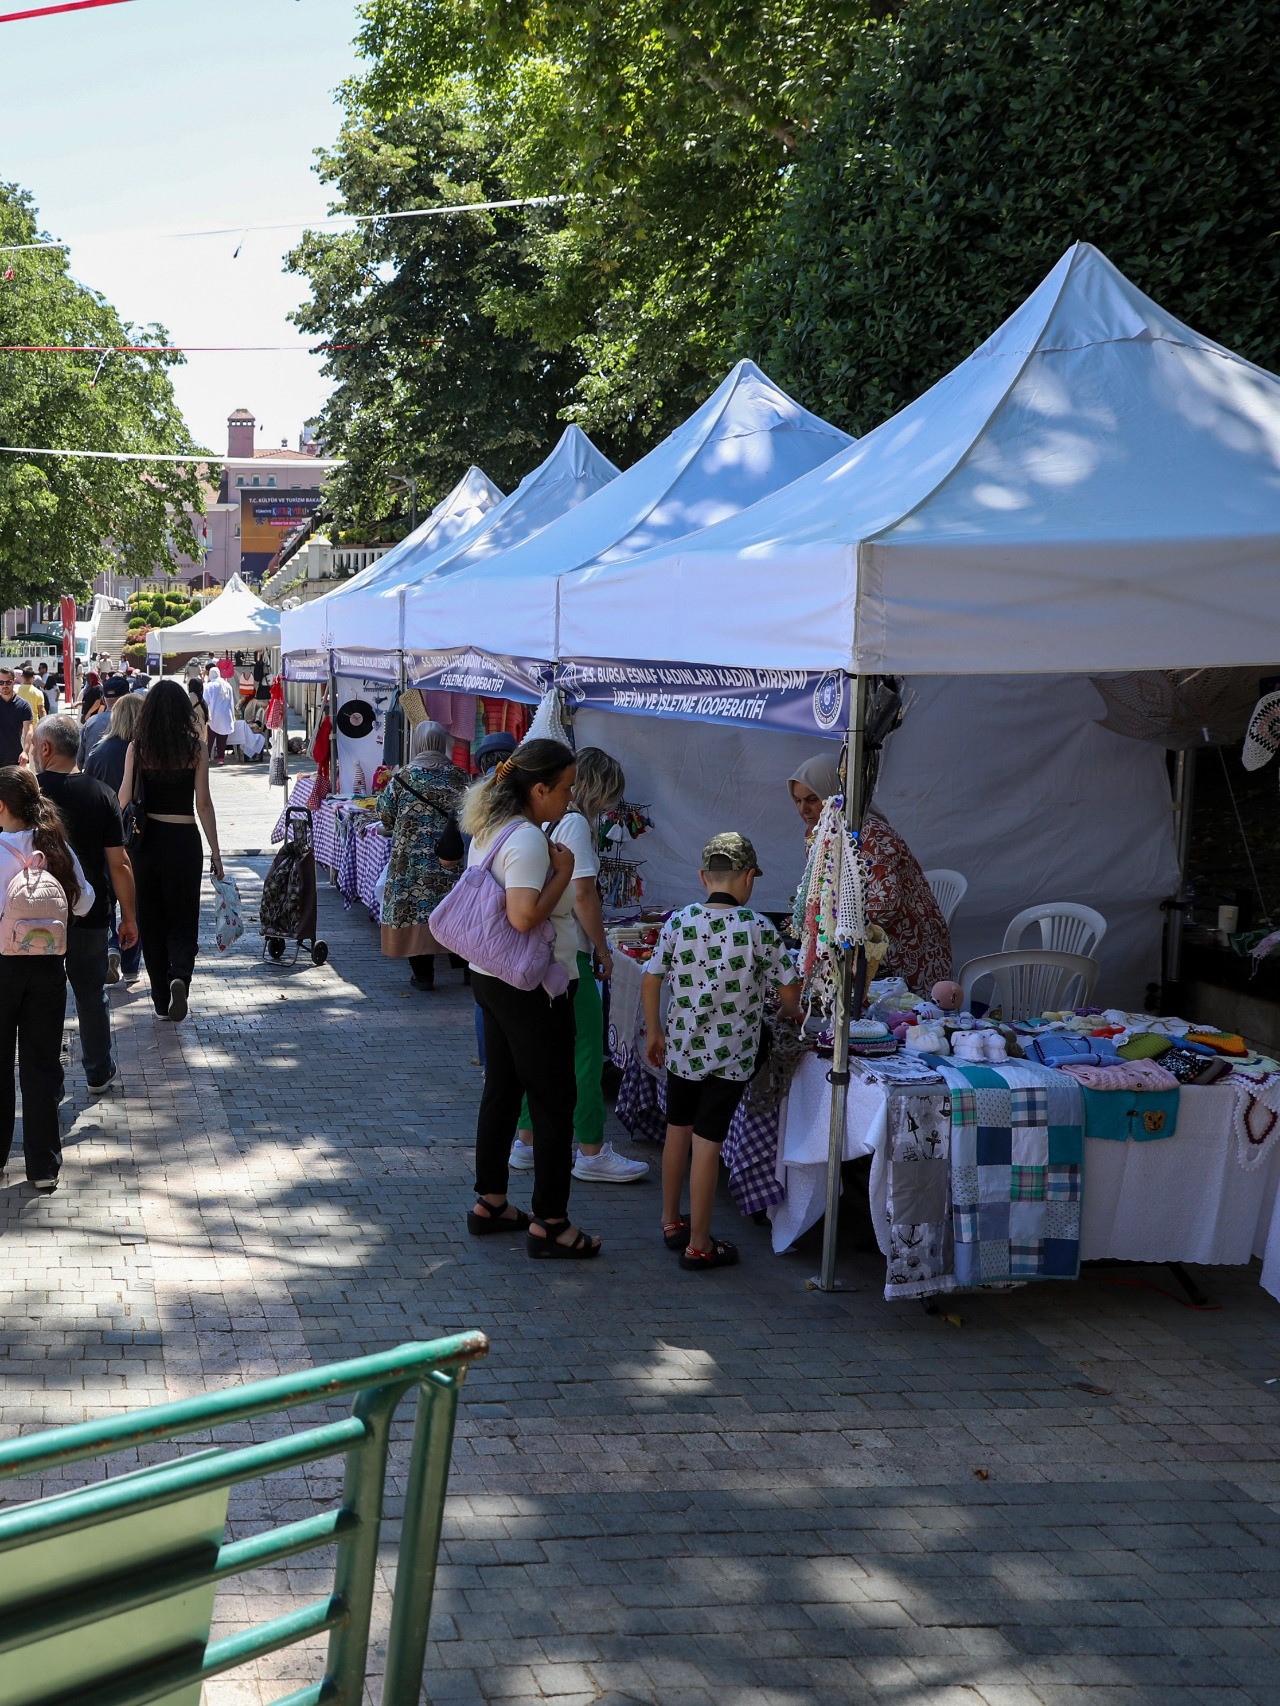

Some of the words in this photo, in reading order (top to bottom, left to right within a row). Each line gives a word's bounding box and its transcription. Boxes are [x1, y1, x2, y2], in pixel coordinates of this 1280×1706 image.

[463, 674, 506, 692] KOOPERATİFİ
[582, 666, 596, 683] S.S.
[598, 667, 627, 684] BURSA
[626, 668, 658, 684] ESNAF
[658, 668, 718, 686] KADINLARI
[715, 668, 756, 688] KADIN
[612, 687, 644, 708] ÜRETİM
[645, 692, 658, 710] VE
[656, 688, 695, 715] İŞLETME
[694, 693, 769, 720] KOOPERATİFİ
